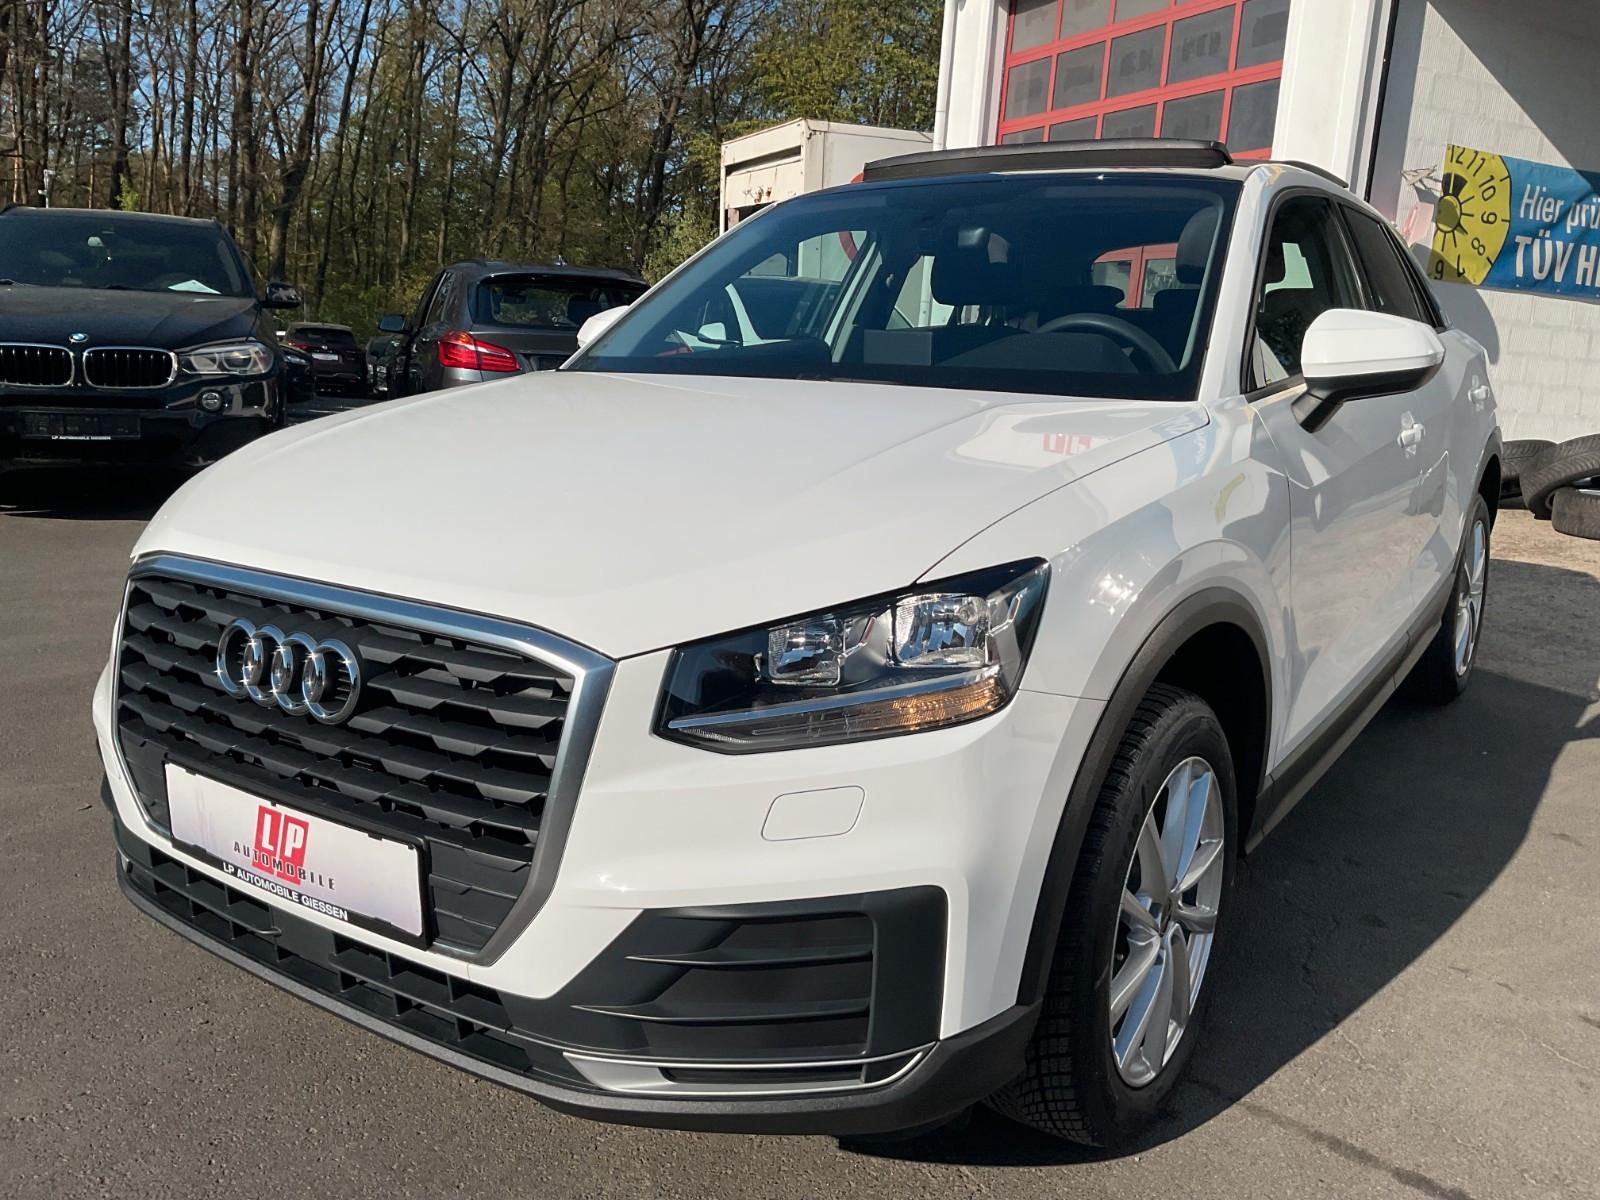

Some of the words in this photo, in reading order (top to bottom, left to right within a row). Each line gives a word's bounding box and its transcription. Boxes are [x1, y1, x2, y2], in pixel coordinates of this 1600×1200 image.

[1448, 144, 1466, 165] 12
[1466, 150, 1486, 177] 11
[1478, 174, 1497, 202] 10
[1519, 183, 1565, 224] Hier
[1471, 237, 1486, 256] 8
[1515, 228, 1575, 283] TÜV
[260, 812, 306, 859] LP
[233, 841, 336, 891] AUTOMOBILE
[222, 861, 236, 874] LP
[236, 868, 300, 903] AUTOMOBILE
[301, 895, 349, 921] GIESSEN
